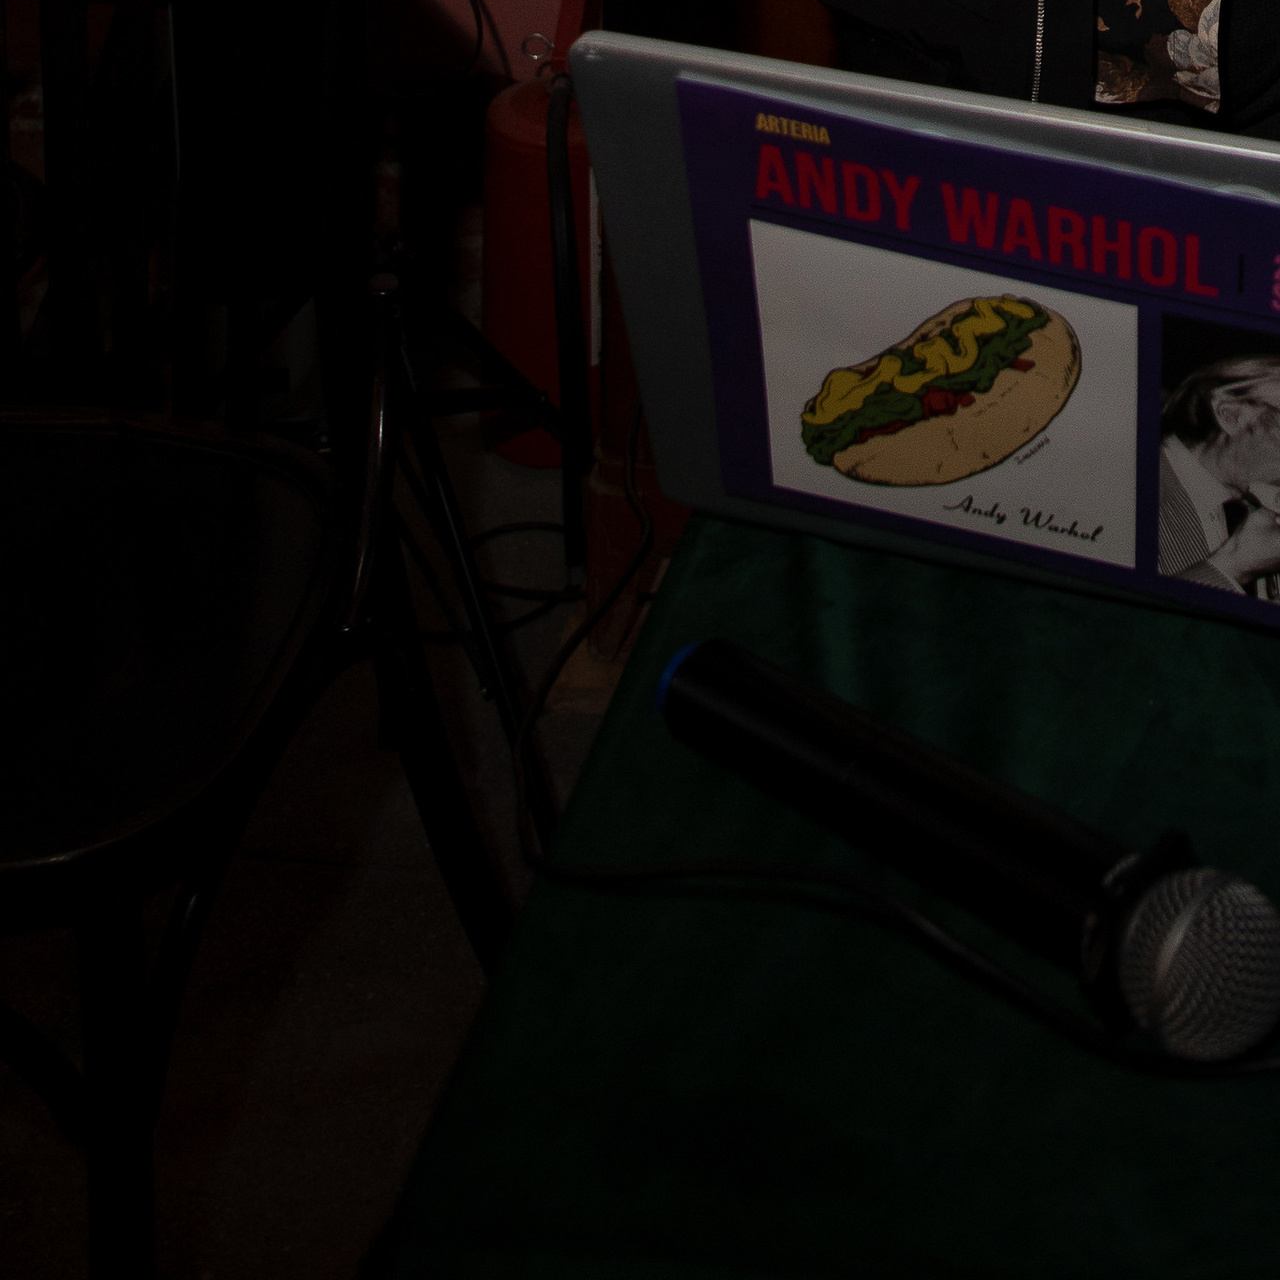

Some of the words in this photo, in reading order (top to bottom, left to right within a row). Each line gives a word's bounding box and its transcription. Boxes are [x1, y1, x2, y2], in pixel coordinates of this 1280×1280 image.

[754, 112, 831, 145] ARTERIA
[755, 143, 921, 232] ANDY
[940, 181, 1220, 299] WARHOL
[943, 495, 1007, 525] Andy
[1021, 507, 1104, 542] Warhol
